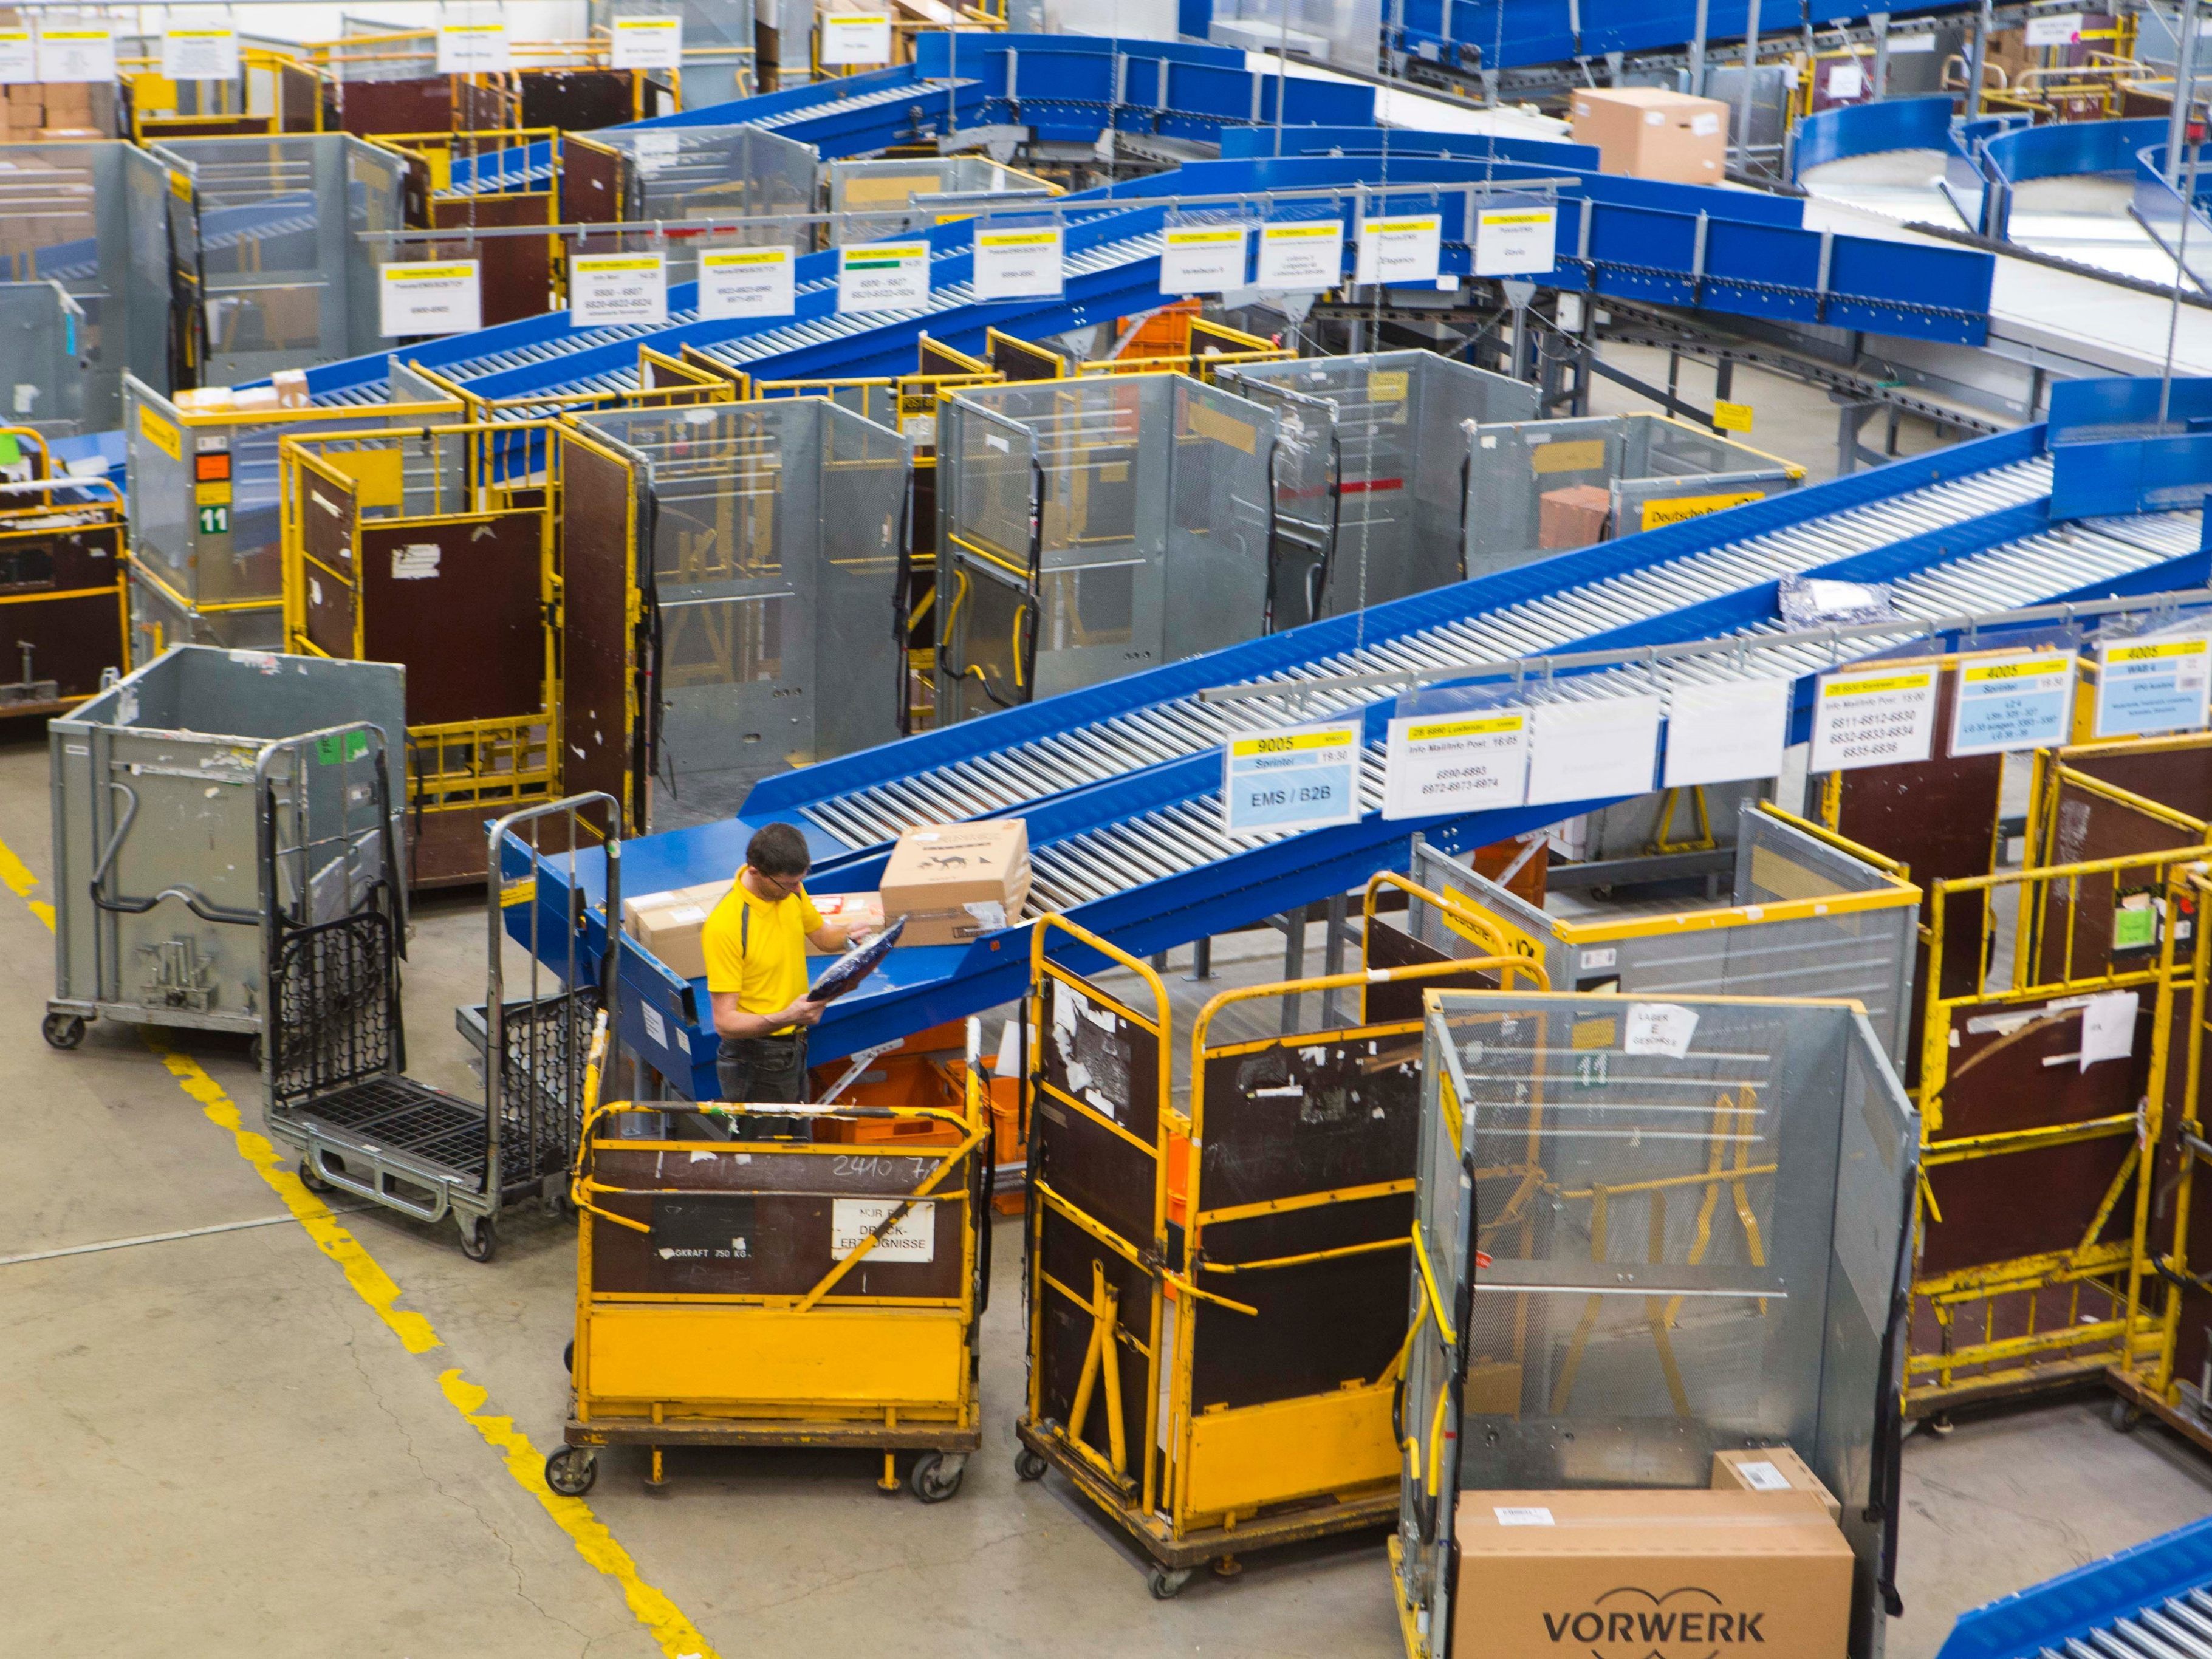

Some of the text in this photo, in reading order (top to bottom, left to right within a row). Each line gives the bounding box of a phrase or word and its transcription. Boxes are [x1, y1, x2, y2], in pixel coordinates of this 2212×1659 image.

[201, 508, 226, 532] 11
[1258, 736, 1294, 753] 9005
[1255, 758, 1295, 770] Sprinter
[1252, 790, 1286, 807] EMS
[1299, 785, 1331, 801] B2B
[859, 1225, 908, 1236] DRCK-
[1542, 1612, 1765, 1643] VORWERK
